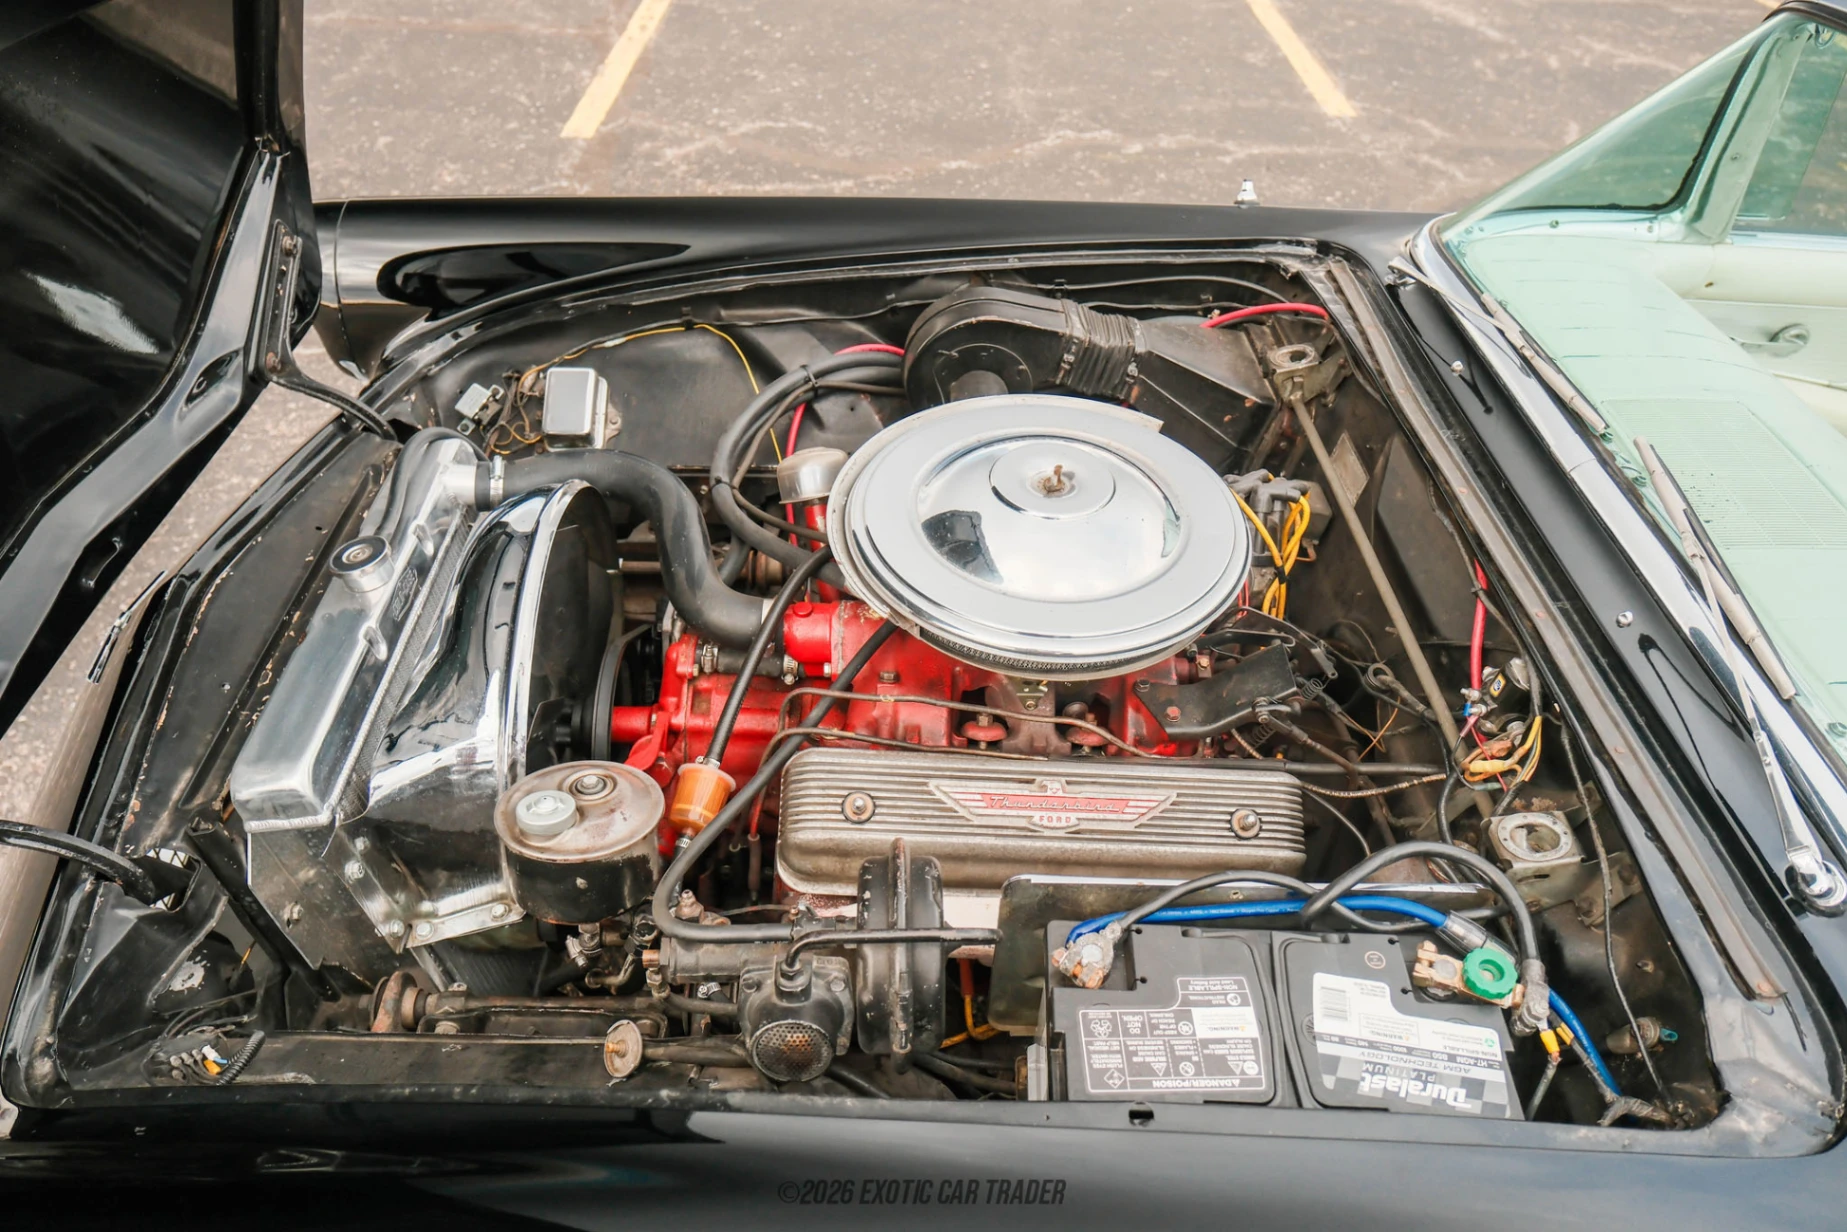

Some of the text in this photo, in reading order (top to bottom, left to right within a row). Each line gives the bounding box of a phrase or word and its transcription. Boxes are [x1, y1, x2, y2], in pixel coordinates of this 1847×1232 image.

[990, 795, 1121, 812] Thunderbird
[1039, 815, 1071, 824] FORD
[1358, 1051, 1439, 1070] TECHNOLOGY
[1443, 1064, 1470, 1074] AGM
[1361, 1062, 1436, 1082] PLATINUM
[1360, 1072, 1472, 1109] Duralast
